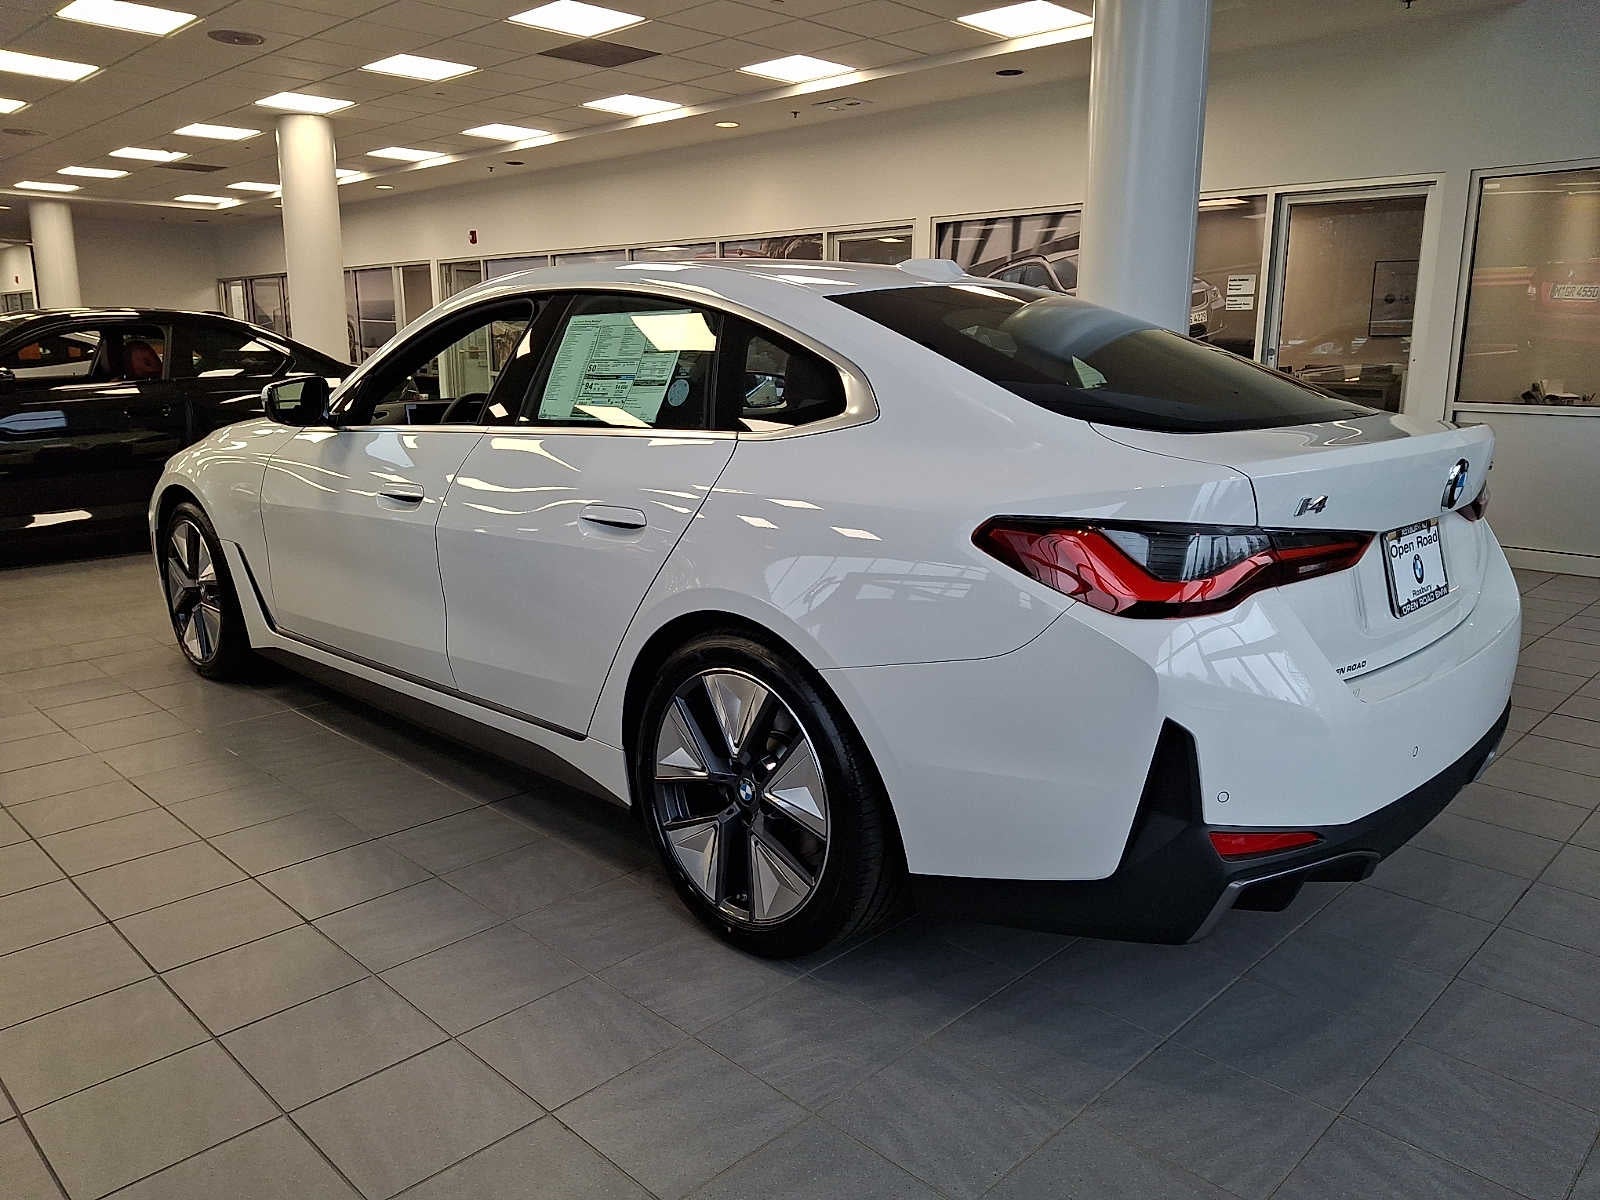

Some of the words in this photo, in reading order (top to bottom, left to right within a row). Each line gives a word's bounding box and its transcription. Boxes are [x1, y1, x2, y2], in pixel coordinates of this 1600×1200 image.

[1390, 542, 1415, 559] Open
[1416, 532, 1438, 549] Road
[1402, 602, 1419, 614] OPEN
[1420, 595, 1435, 607] ROAD
[1346, 660, 1367, 673] ROAD
